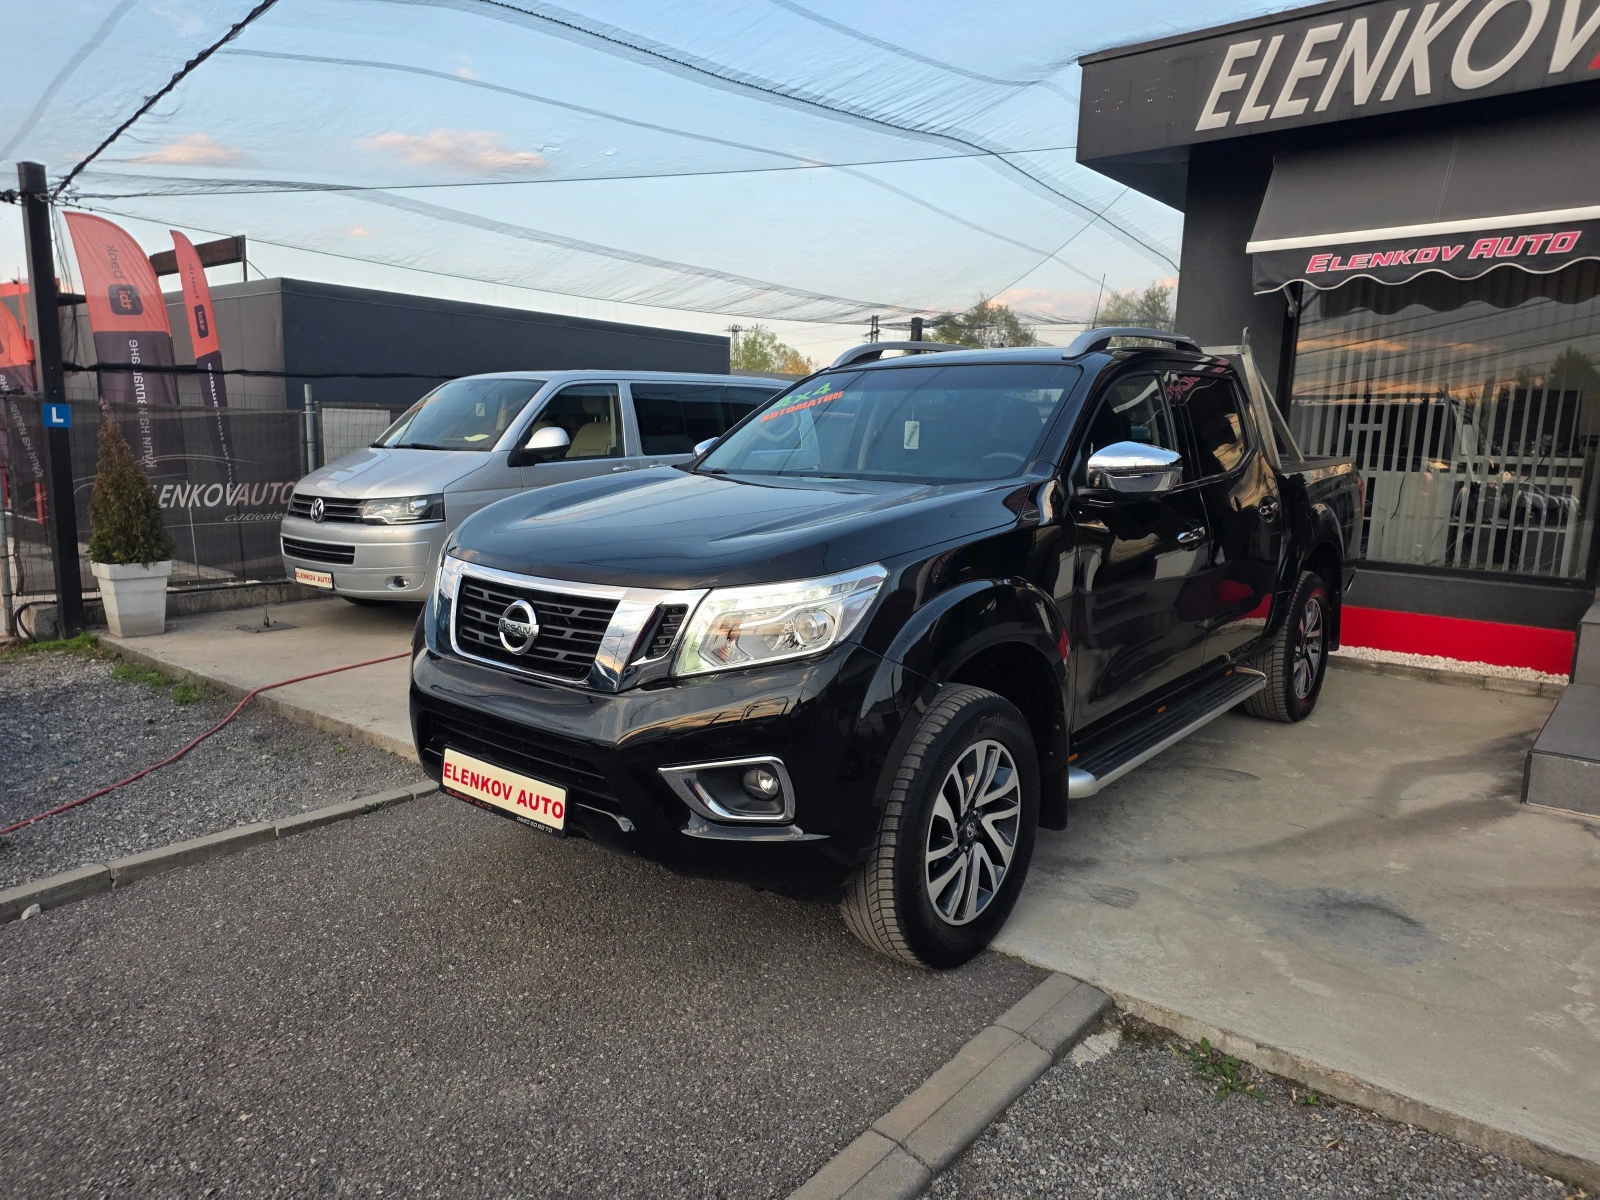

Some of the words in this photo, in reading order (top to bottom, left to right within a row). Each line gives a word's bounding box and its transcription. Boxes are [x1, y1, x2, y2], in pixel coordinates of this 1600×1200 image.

[1305, 245, 1464, 274] ELENKOV
[1468, 230, 1582, 259] AUTO
[51, 406, 65, 423] L
[295, 571, 316, 582] ELENKOV
[317, 575, 332, 584] AUTO
[443, 762, 513, 801] ELENKOV
[516, 789, 565, 819] AUTO
